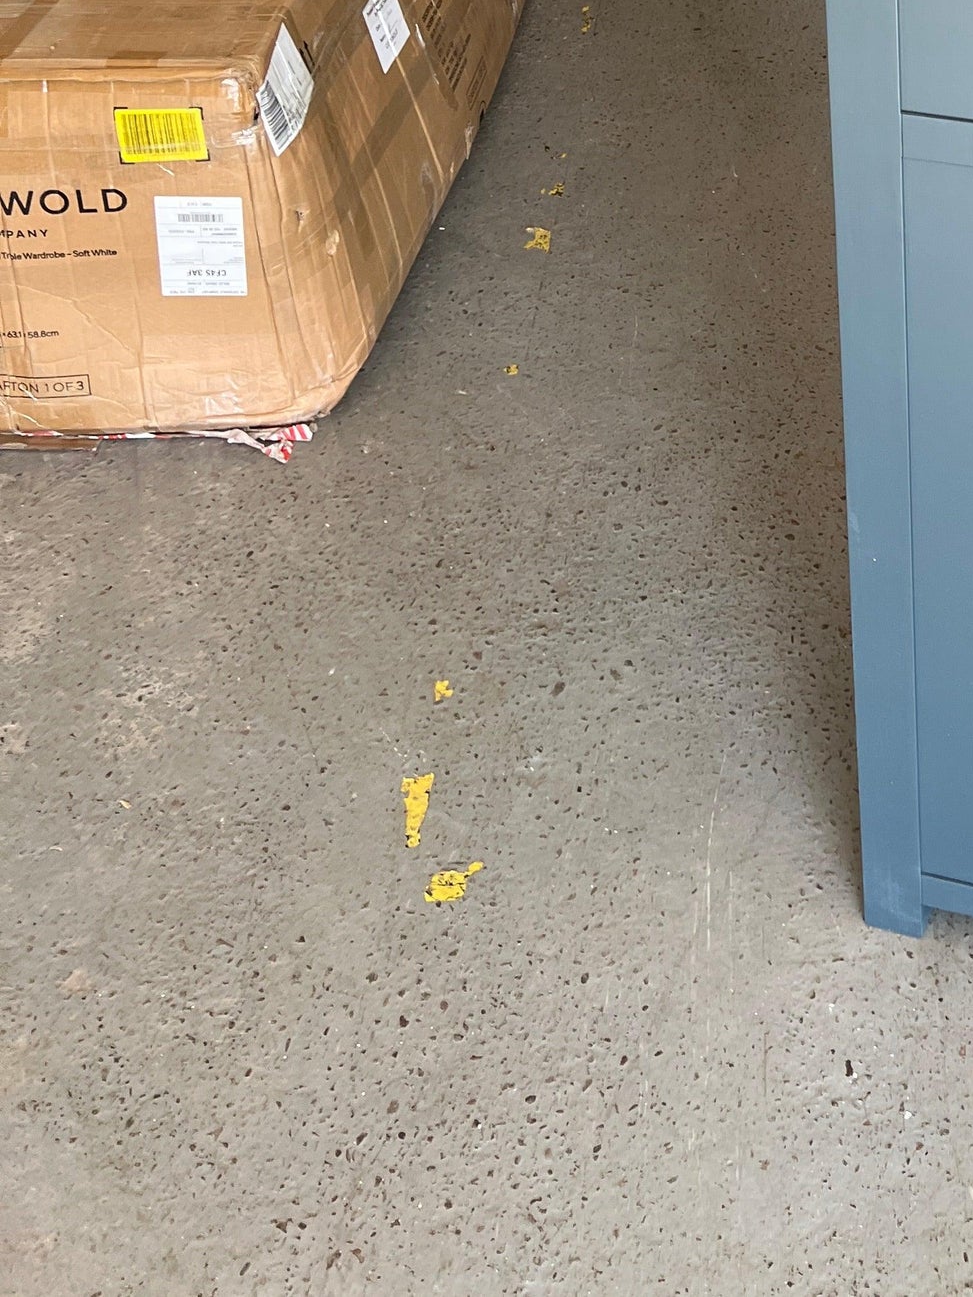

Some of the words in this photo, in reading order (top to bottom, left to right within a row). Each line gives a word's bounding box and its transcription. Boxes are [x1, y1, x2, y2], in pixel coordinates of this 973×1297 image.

[0, 188, 128, 216] WOLD
[22, 251, 66, 260] Wardrobe
[73, 249, 91, 258] Soft
[91, 248, 118, 257] White
